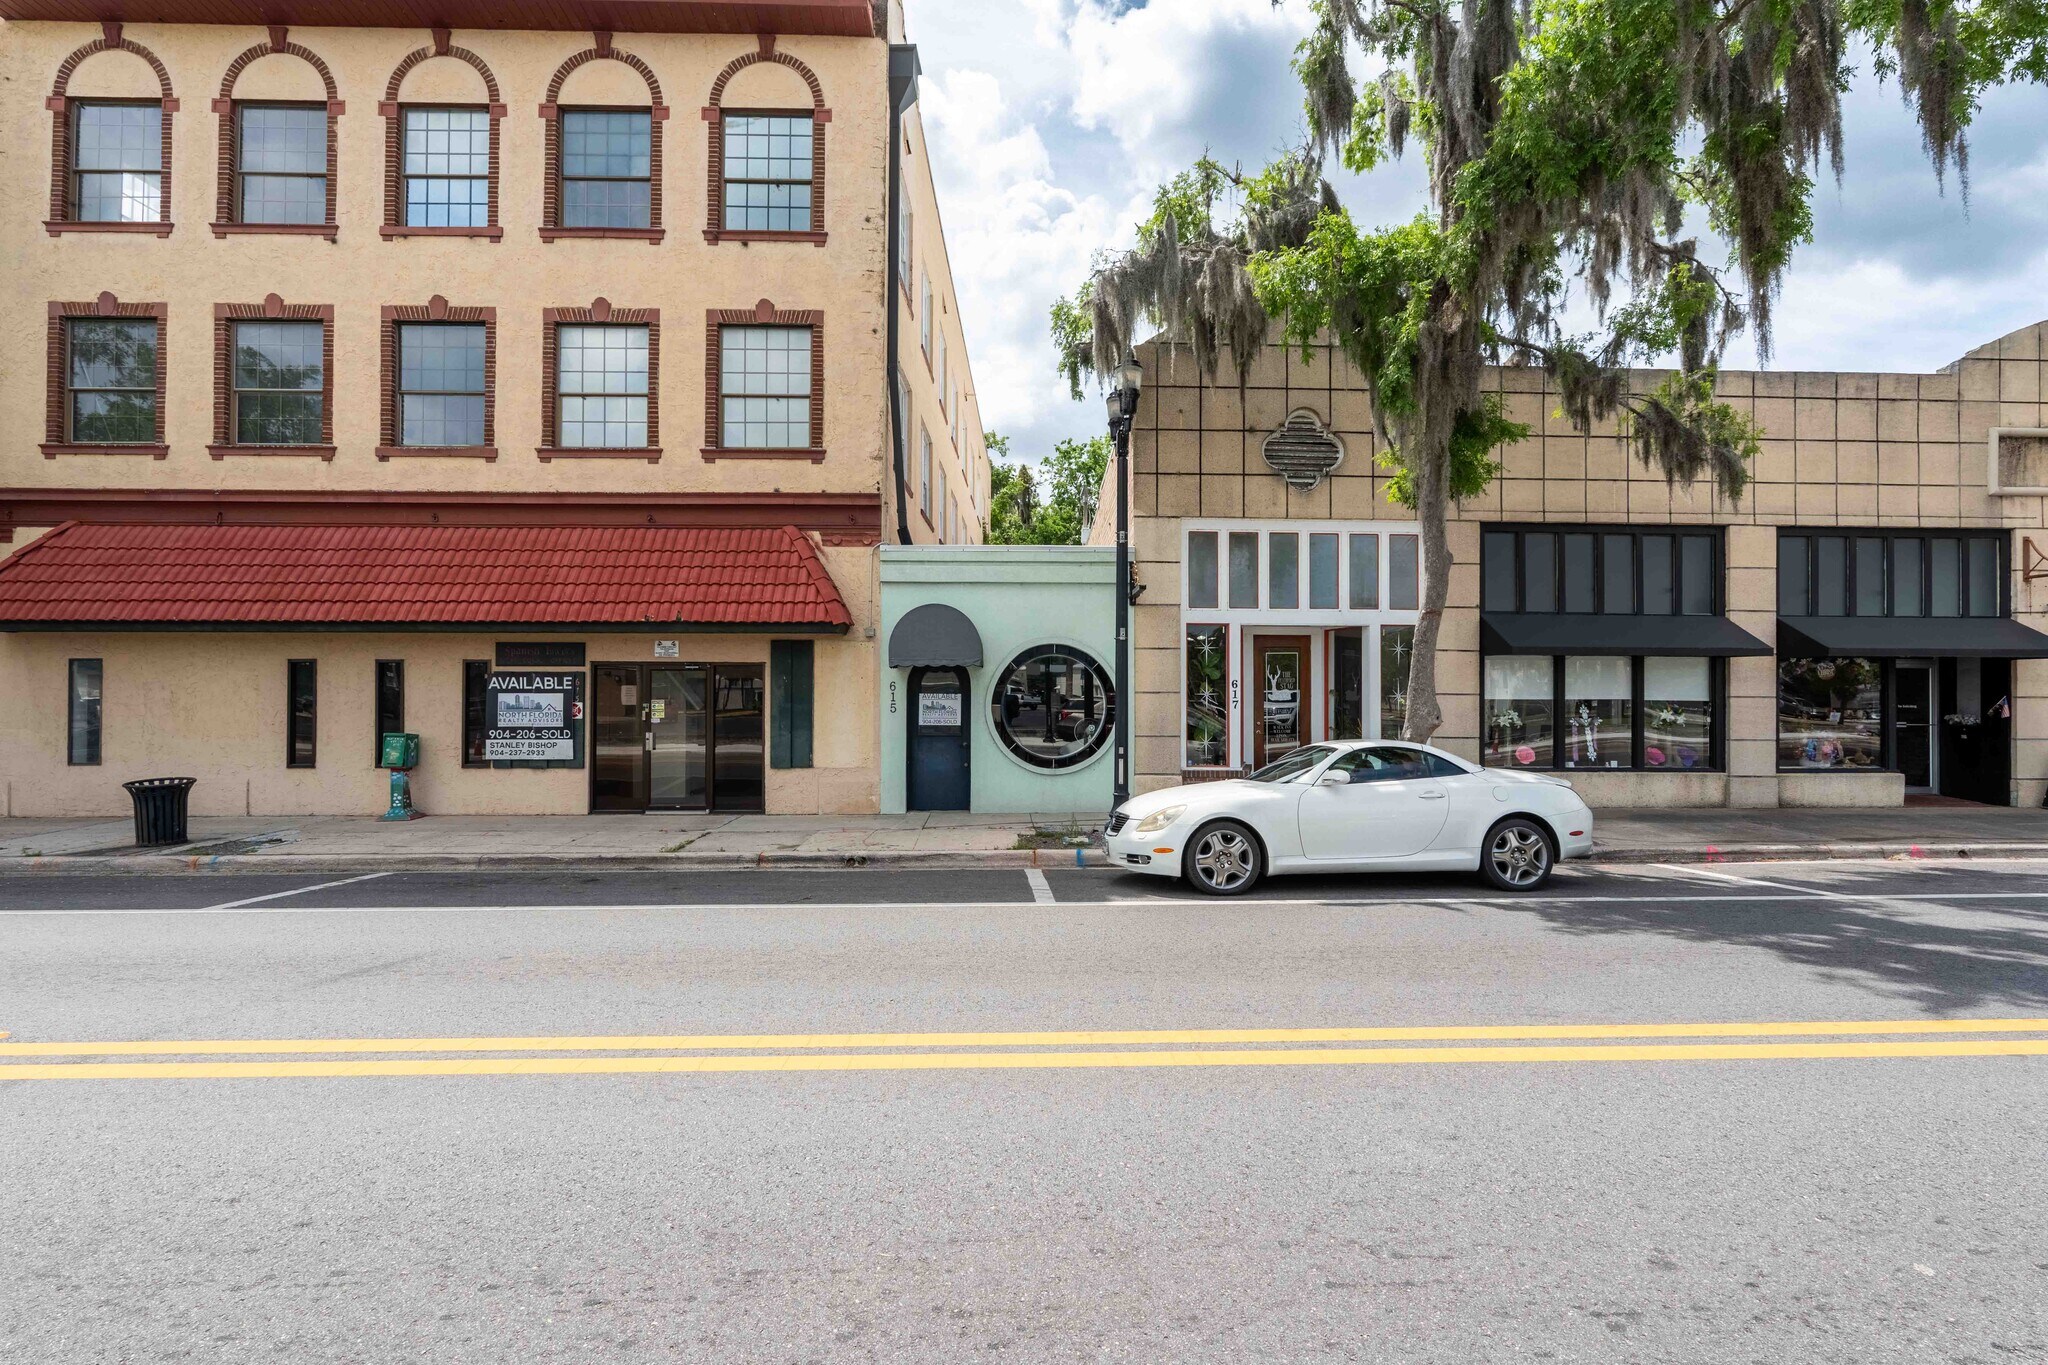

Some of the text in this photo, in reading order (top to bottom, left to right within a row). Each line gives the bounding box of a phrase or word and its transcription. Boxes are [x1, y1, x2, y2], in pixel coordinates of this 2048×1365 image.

[488, 677, 573, 689] AVAILABLE
[889, 681, 897, 713] 615
[1231, 680, 1239, 709] 617
[488, 730, 571, 739] 904-206-SOLD
